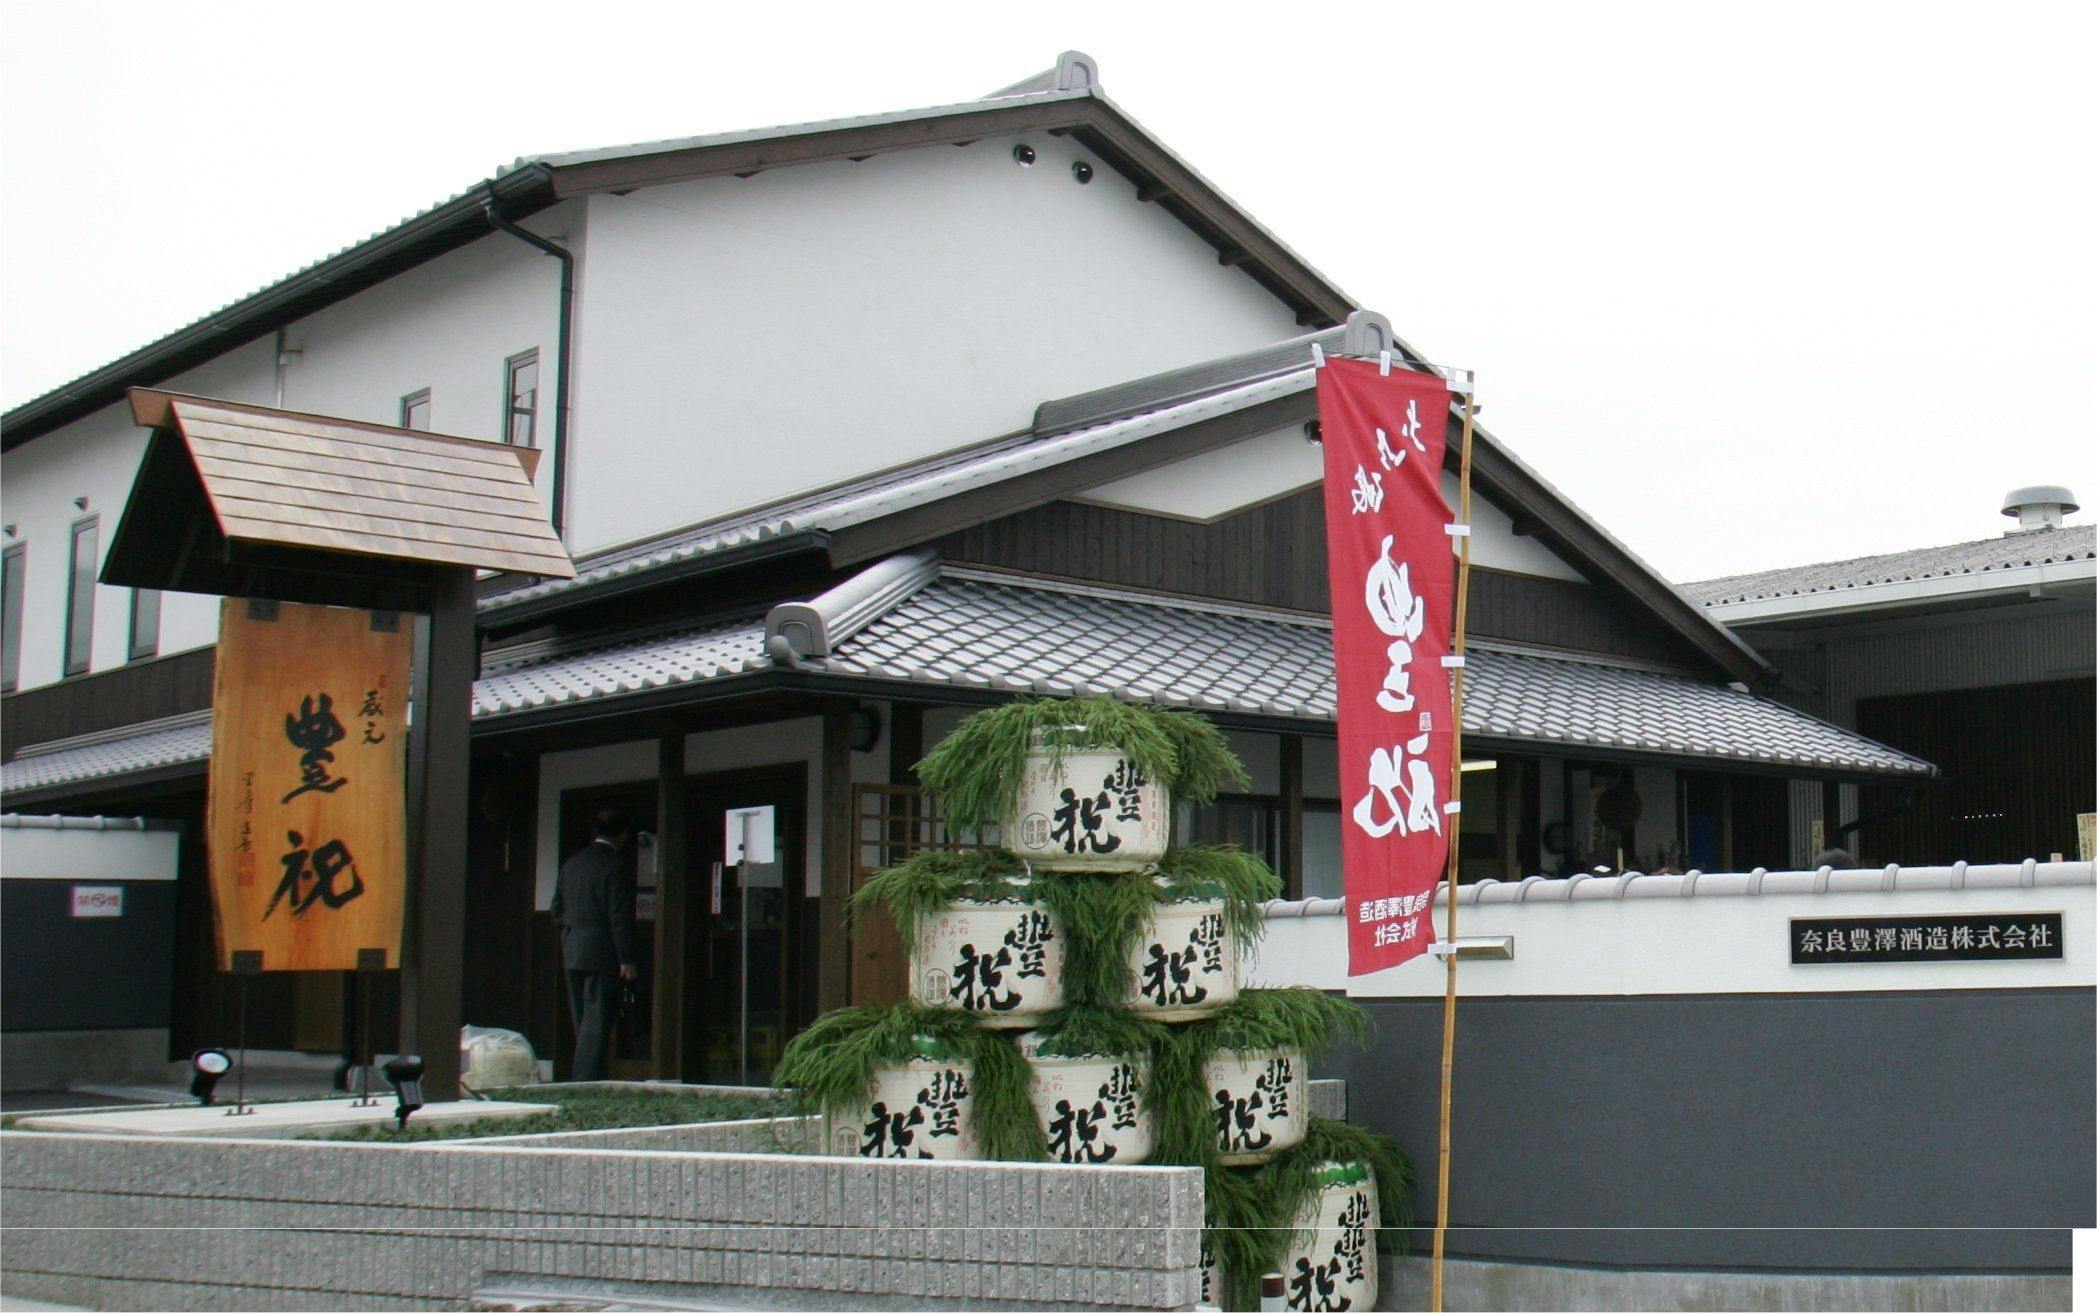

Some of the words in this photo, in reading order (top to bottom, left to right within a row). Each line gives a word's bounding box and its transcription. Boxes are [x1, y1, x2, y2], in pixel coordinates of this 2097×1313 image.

[1800, 923, 2053, 954] 奈良豊澤酒造株式会社
